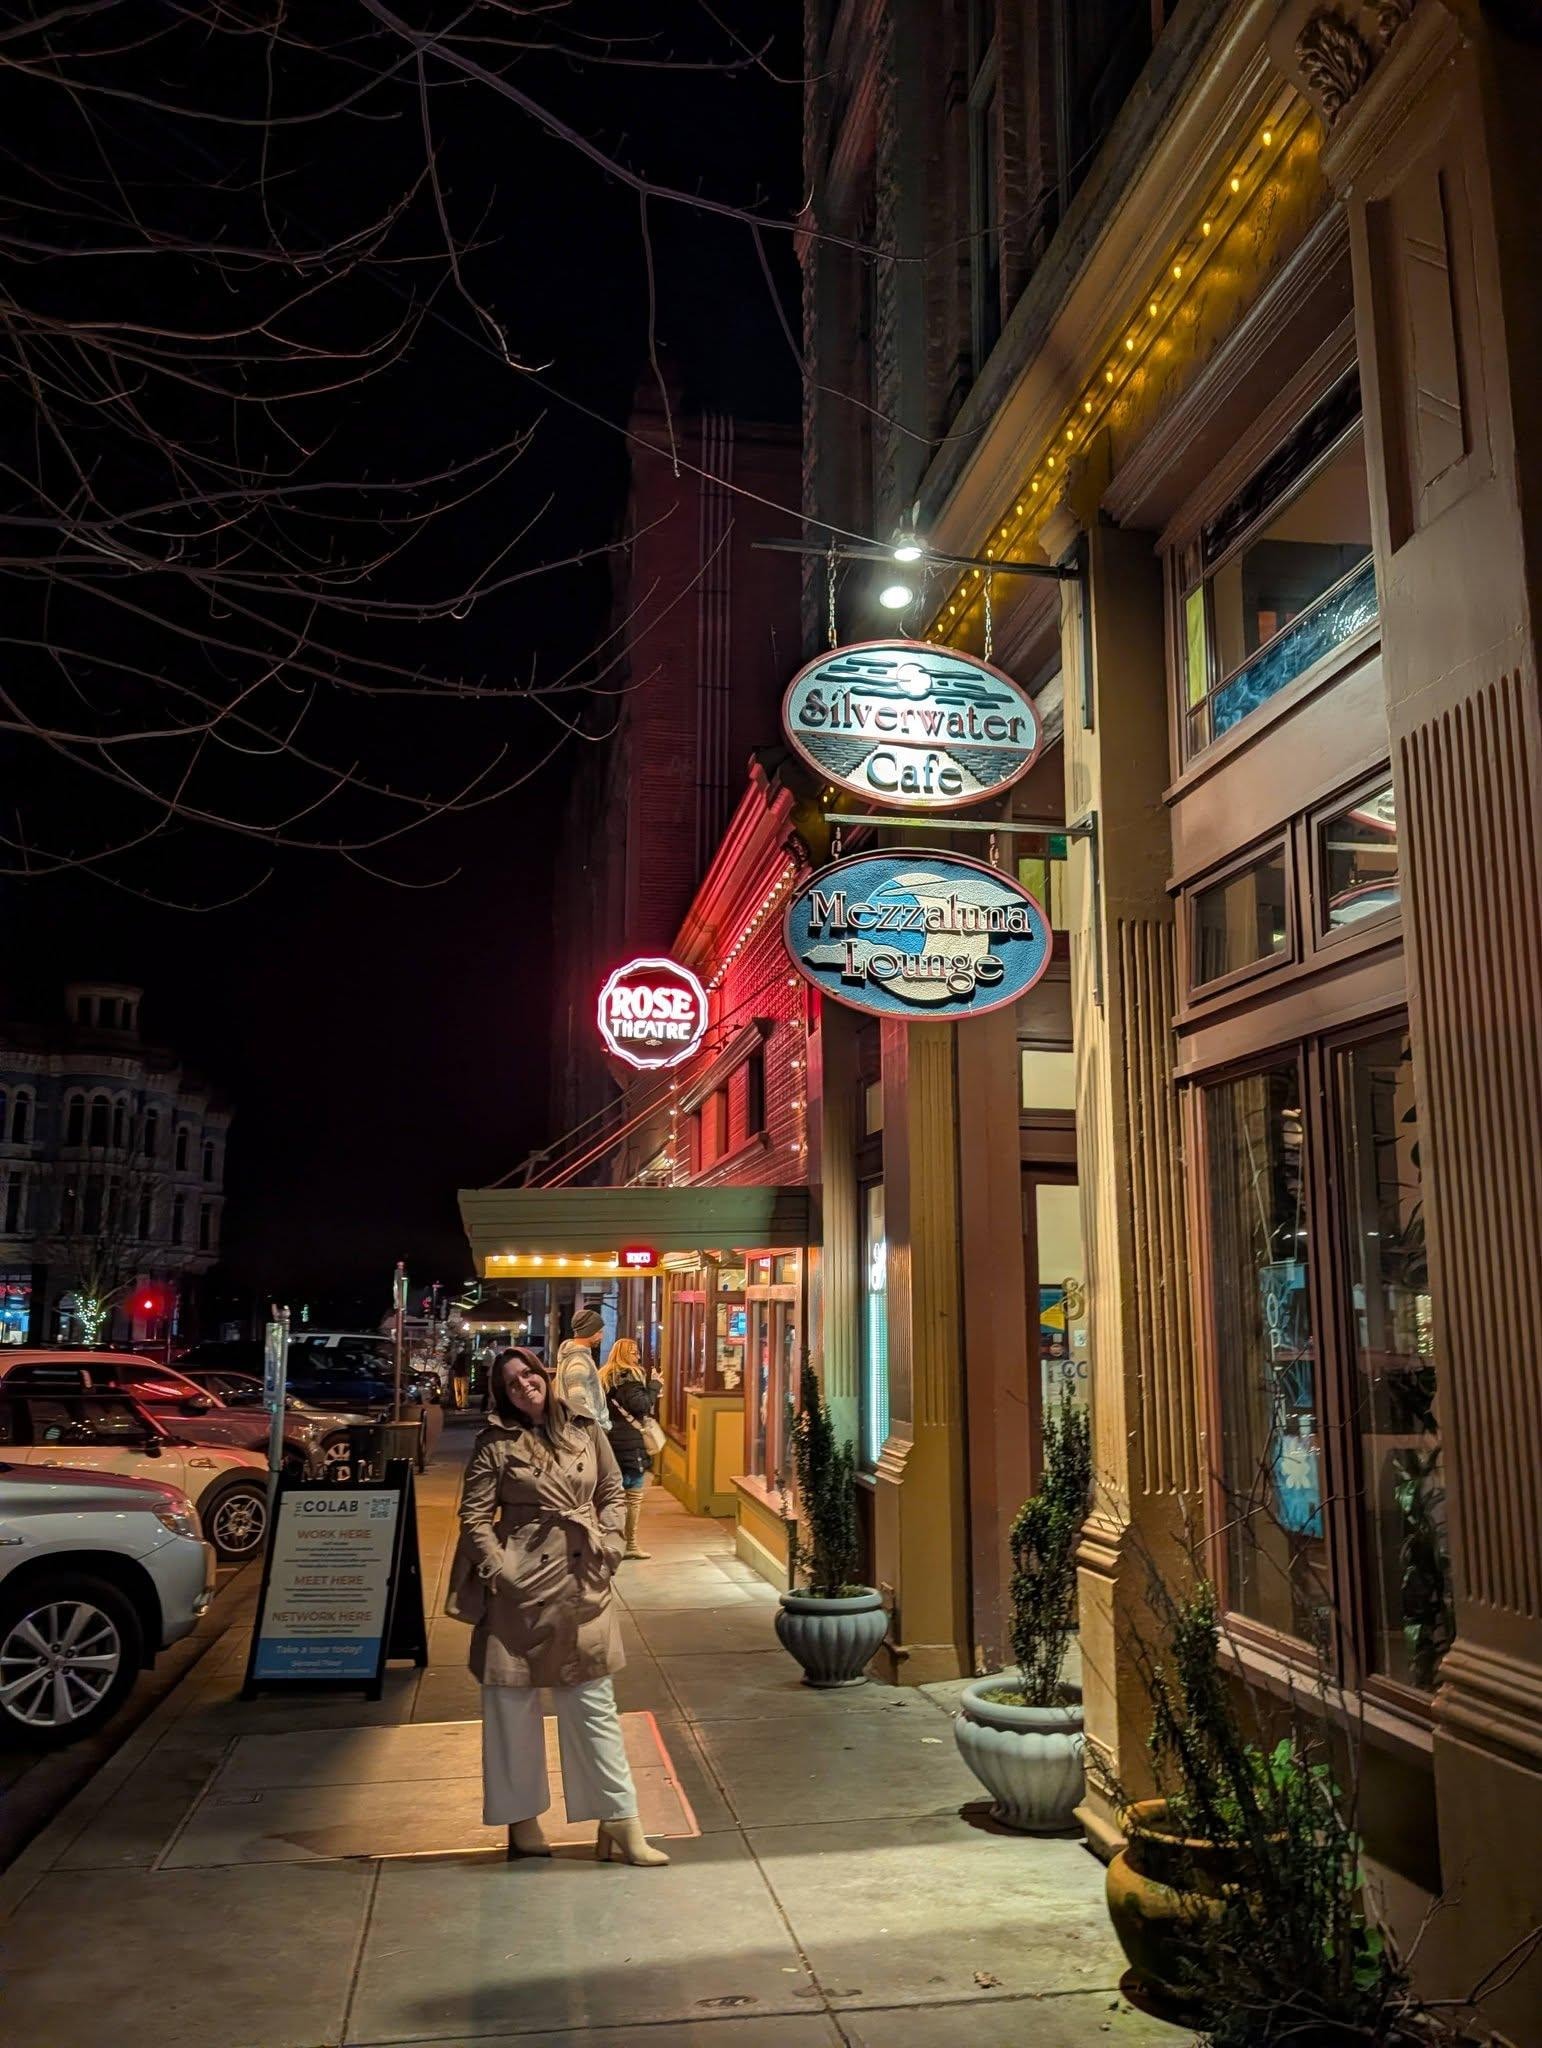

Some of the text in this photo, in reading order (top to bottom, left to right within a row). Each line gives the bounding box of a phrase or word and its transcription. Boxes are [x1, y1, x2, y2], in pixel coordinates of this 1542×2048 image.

[799, 688, 1025, 743] Silverwater
[866, 751, 964, 796] Cafe
[808, 890, 1032, 934] Mezzaluna
[841, 941, 1004, 994] Lounge
[611, 986, 695, 1020] ROSE
[611, 1019, 691, 1040] THEATRE
[303, 1501, 359, 1513] COLAB
[297, 1530, 371, 1539] WORK HERE
[294, 1576, 364, 1585] MEET HERE
[272, 1611, 373, 1622] NETWORK HERE
